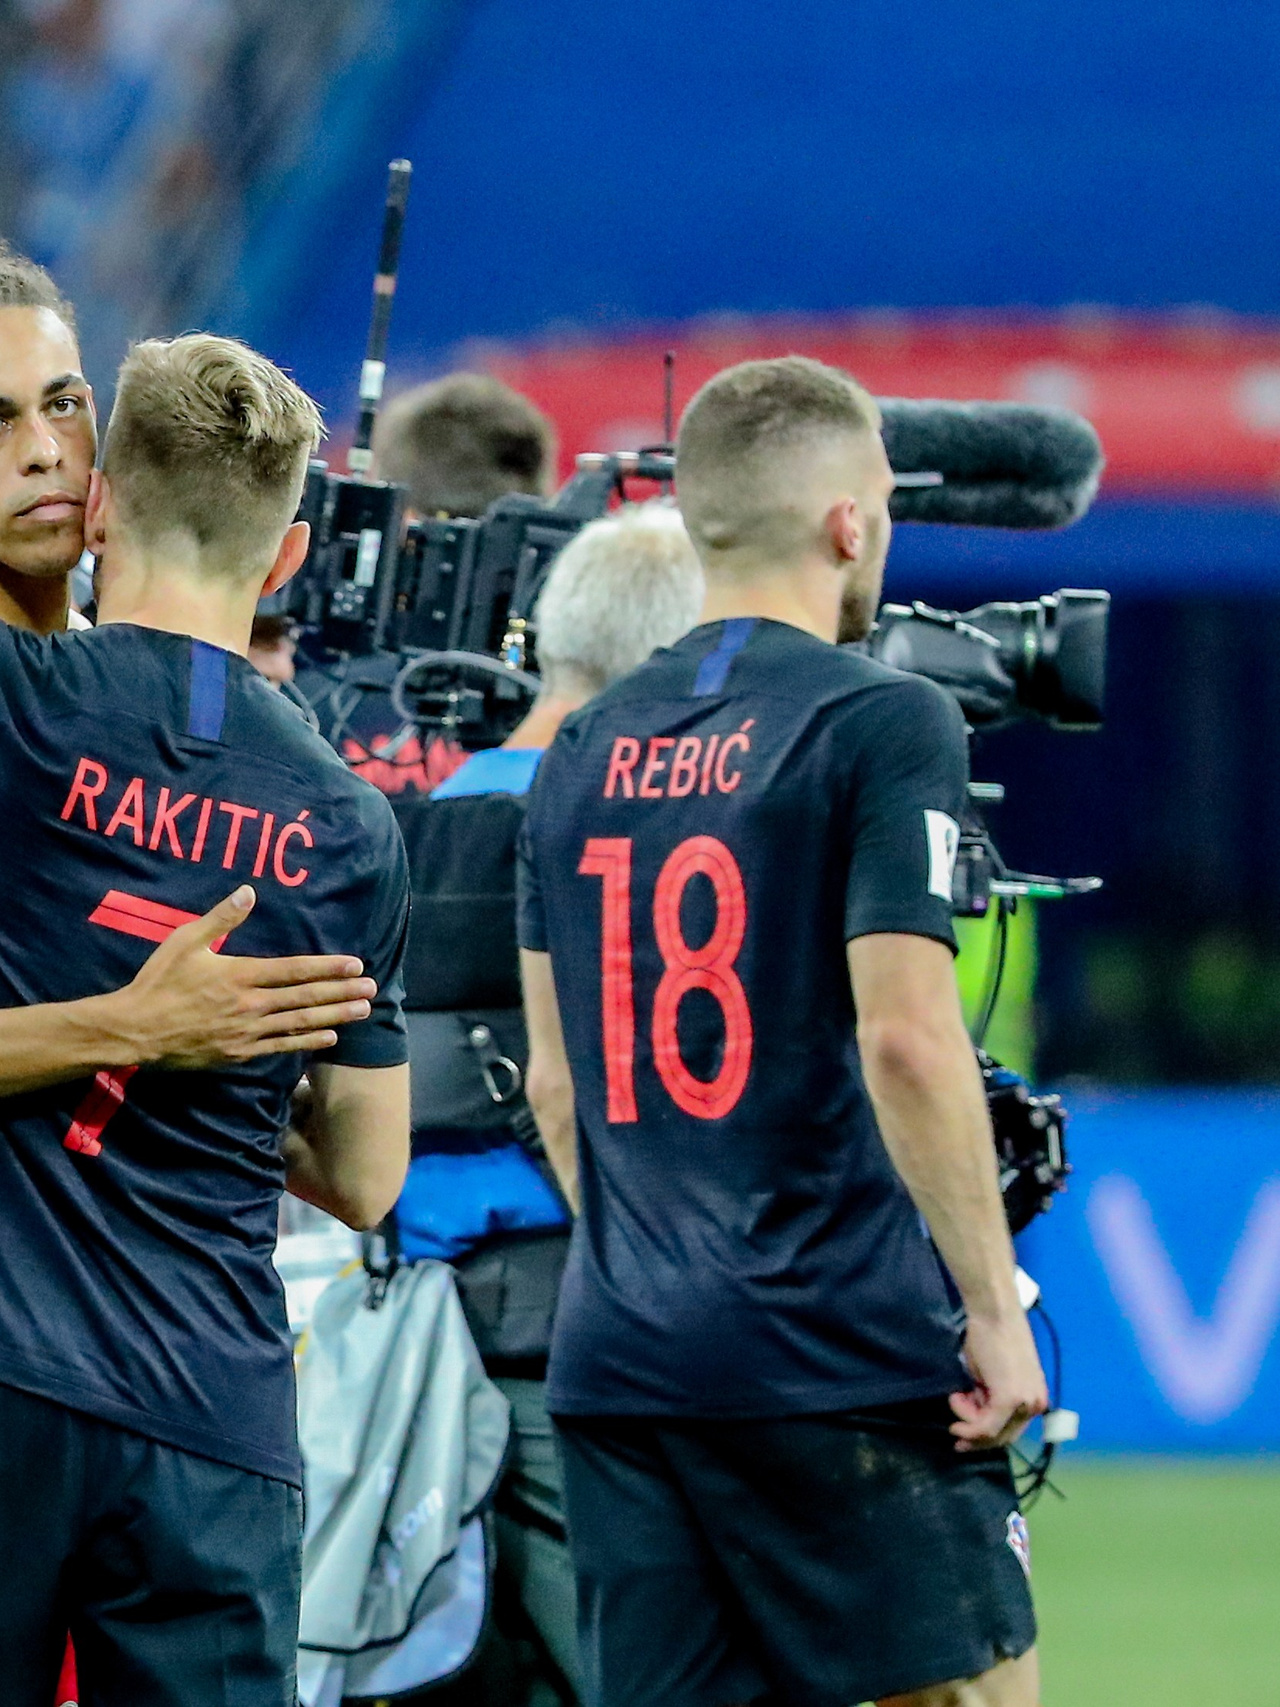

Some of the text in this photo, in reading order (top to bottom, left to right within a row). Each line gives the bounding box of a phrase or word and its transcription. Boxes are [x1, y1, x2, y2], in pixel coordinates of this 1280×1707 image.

[60, 757, 315, 887] RAKITIĆ
[604, 719, 756, 799] REBIĆ
[63, 889, 230, 1156] 7
[577, 835, 754, 1124] 18
